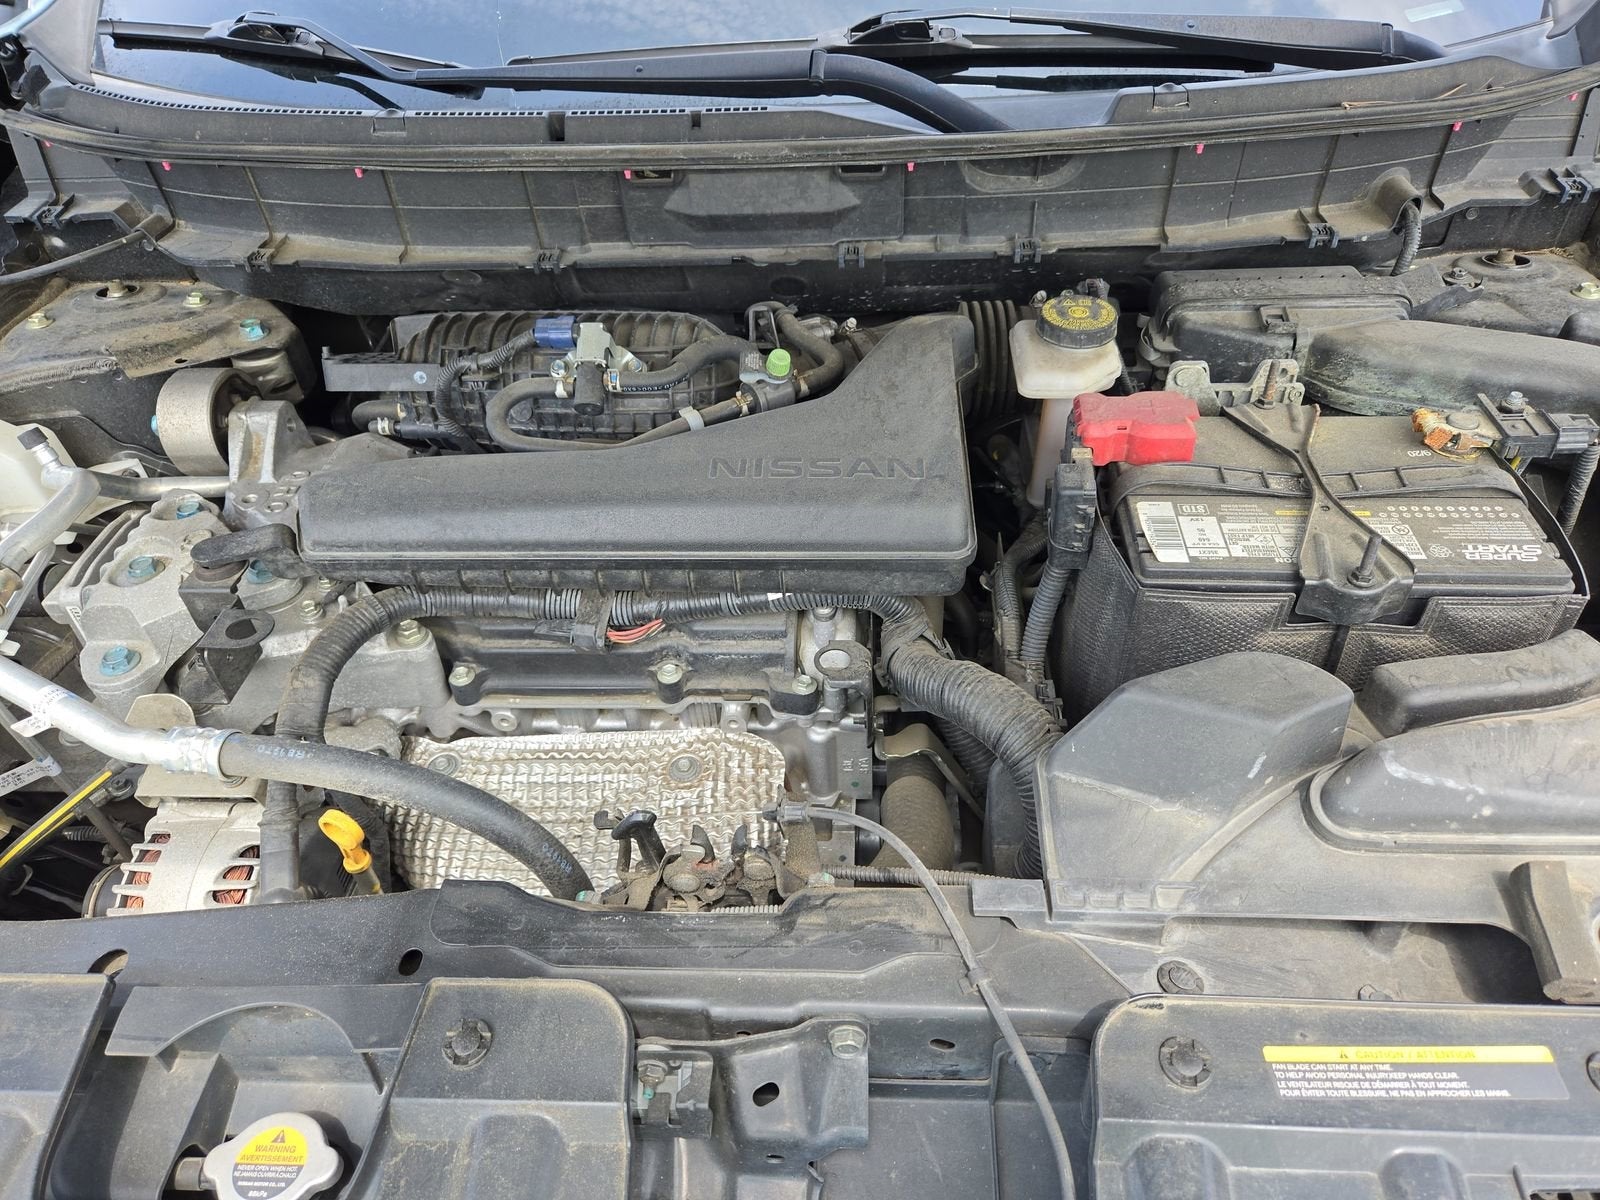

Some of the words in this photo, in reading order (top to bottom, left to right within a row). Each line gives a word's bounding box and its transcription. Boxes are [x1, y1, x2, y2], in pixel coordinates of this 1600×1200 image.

[708, 457, 927, 479] NISSAN
[1462, 544, 1543, 554] START
[1464, 552, 1539, 562] SUPER
[1280, 1089, 1300, 1097] POUR
[1301, 1088, 1326, 1097] ÉVITER
[1326, 1089, 1349, 1097] TOUTE
[1427, 1089, 1471, 1097] APPROCHER
[255, 1145, 297, 1153] WARNING
[239, 1154, 304, 1163] AVERTISSEMENT
